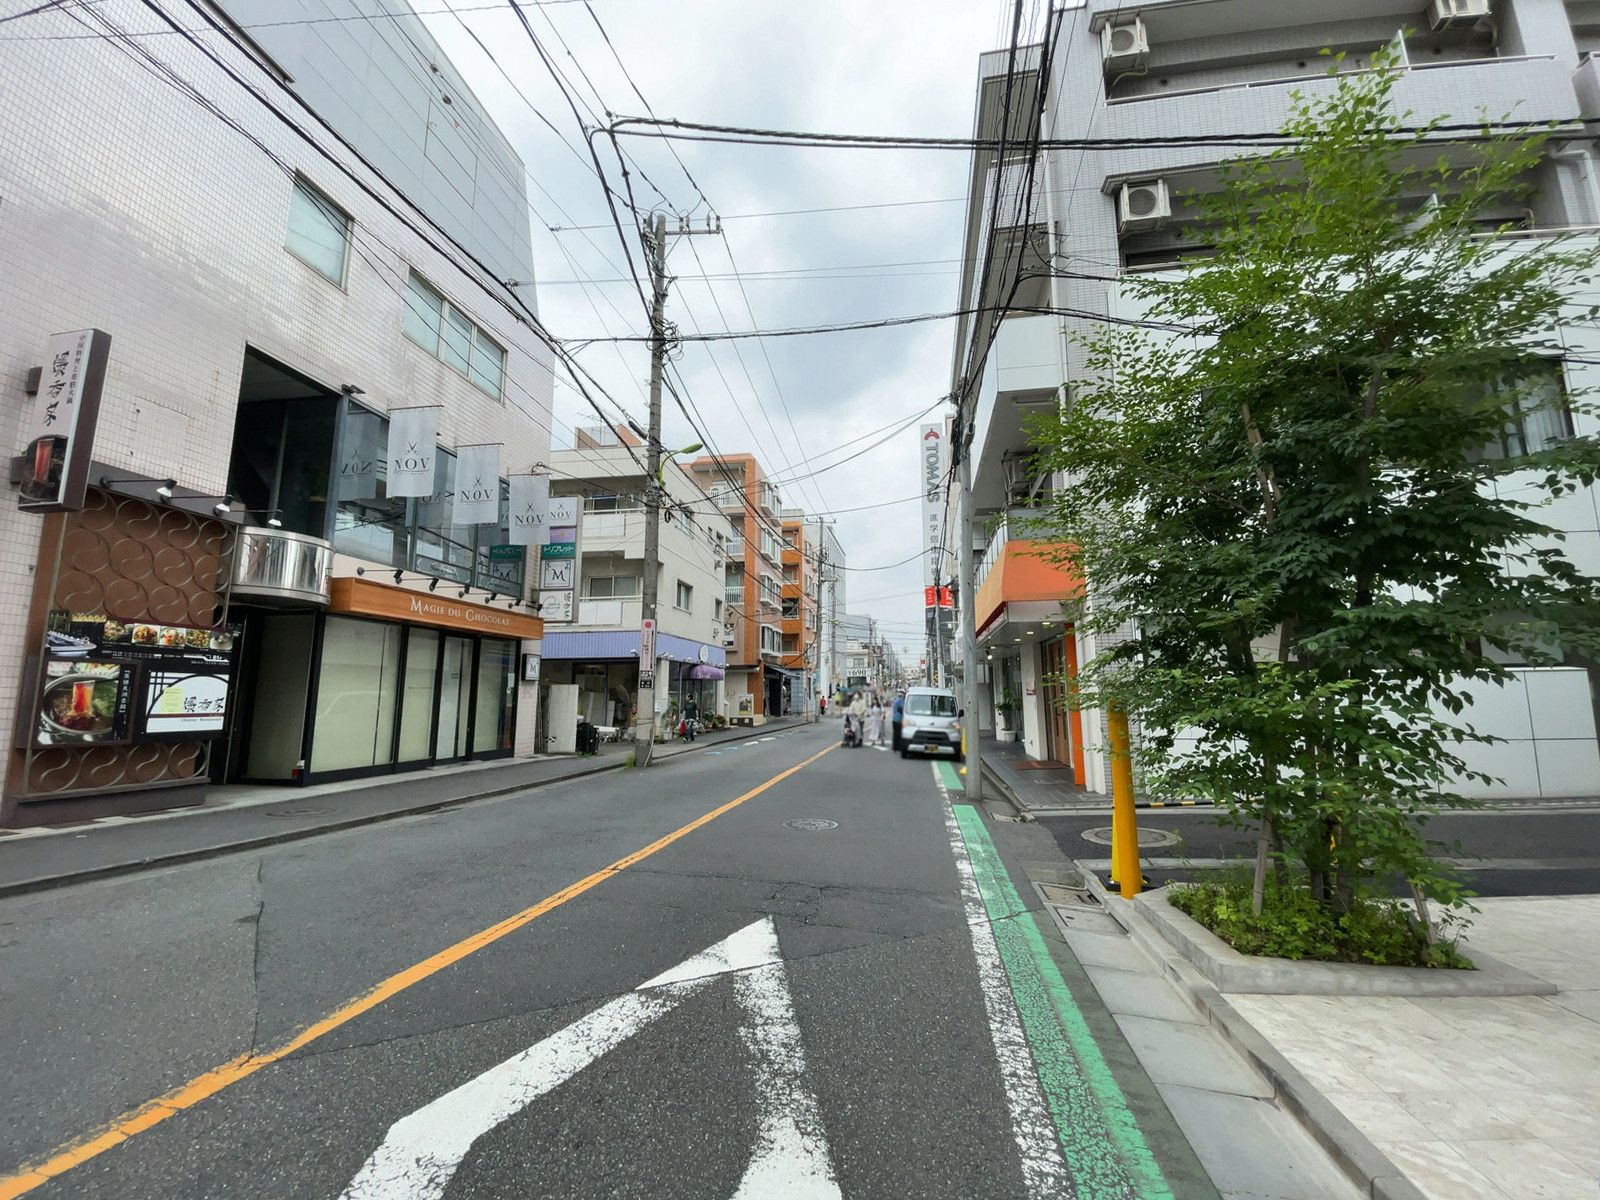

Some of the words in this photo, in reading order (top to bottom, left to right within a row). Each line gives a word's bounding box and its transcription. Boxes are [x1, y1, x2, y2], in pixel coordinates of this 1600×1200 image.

[394, 457, 430, 471] NOV
[925, 442, 940, 504] TOMAS
[460, 489, 494, 502] NOV
[515, 514, 544, 525] NOV
[550, 511, 572, 519] NOV
[552, 568, 567, 582] M
[410, 596, 445, 615] MAGIE
[448, 608, 460, 617] DU
[465, 609, 510, 626] CHOCOLAT
[530, 662, 537, 674] M
